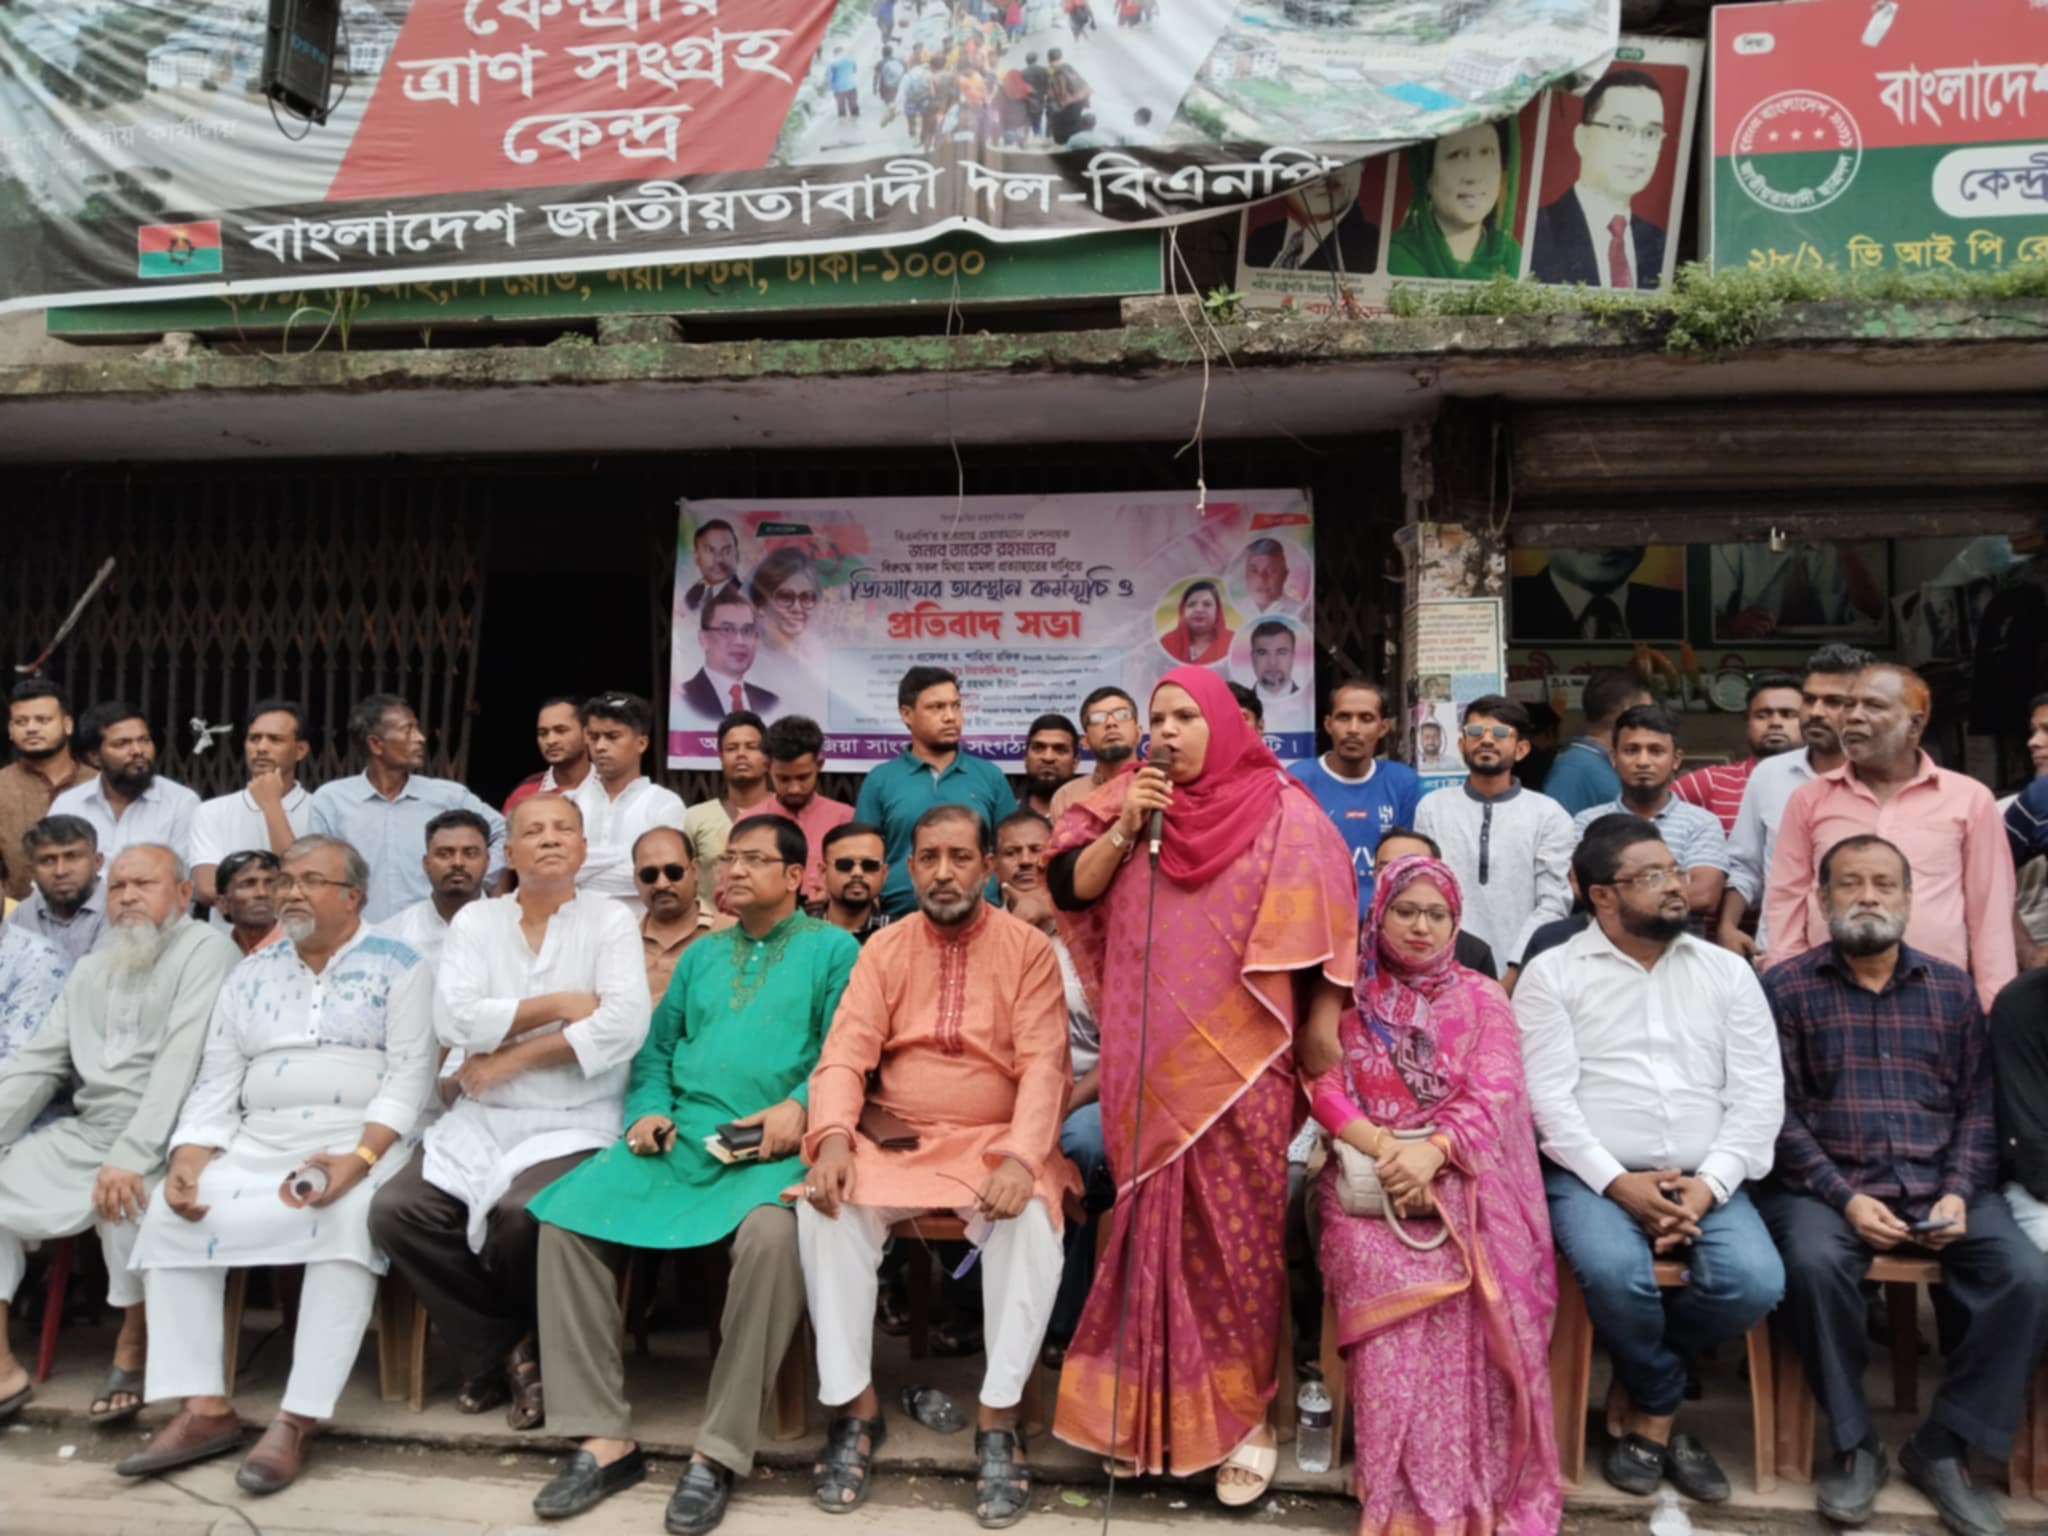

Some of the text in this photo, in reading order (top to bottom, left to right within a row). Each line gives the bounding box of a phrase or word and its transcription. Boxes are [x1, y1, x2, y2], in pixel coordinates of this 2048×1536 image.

[396, 43, 549, 107] ত্রাণ
[564, 26, 795, 92] সংগ্রহ
[502, 103, 695, 165] কেন্দ্র
[243, 202, 526, 263] বাংলাদেশ
[539, 158, 946, 241] জাতীয়তাবাদী
[787, 248, 986, 285] ঢাকা-১০০০
[1845, 233, 1885, 270] ভি
[1893, 231, 1957, 269] আই
[1966, 229, 2004, 267] পি
[908, 541, 1056, 558] জনাব তারেক রহমানের
[951, 578, 1022, 601] অবস্থান
[1030, 565, 1115, 604] কর্মসূচি
[1118, 578, 1135, 598] ও
[887, 600, 1083, 639] প্রতিবাদ সভা
[966, 737, 1028, 756] সংগঠ
